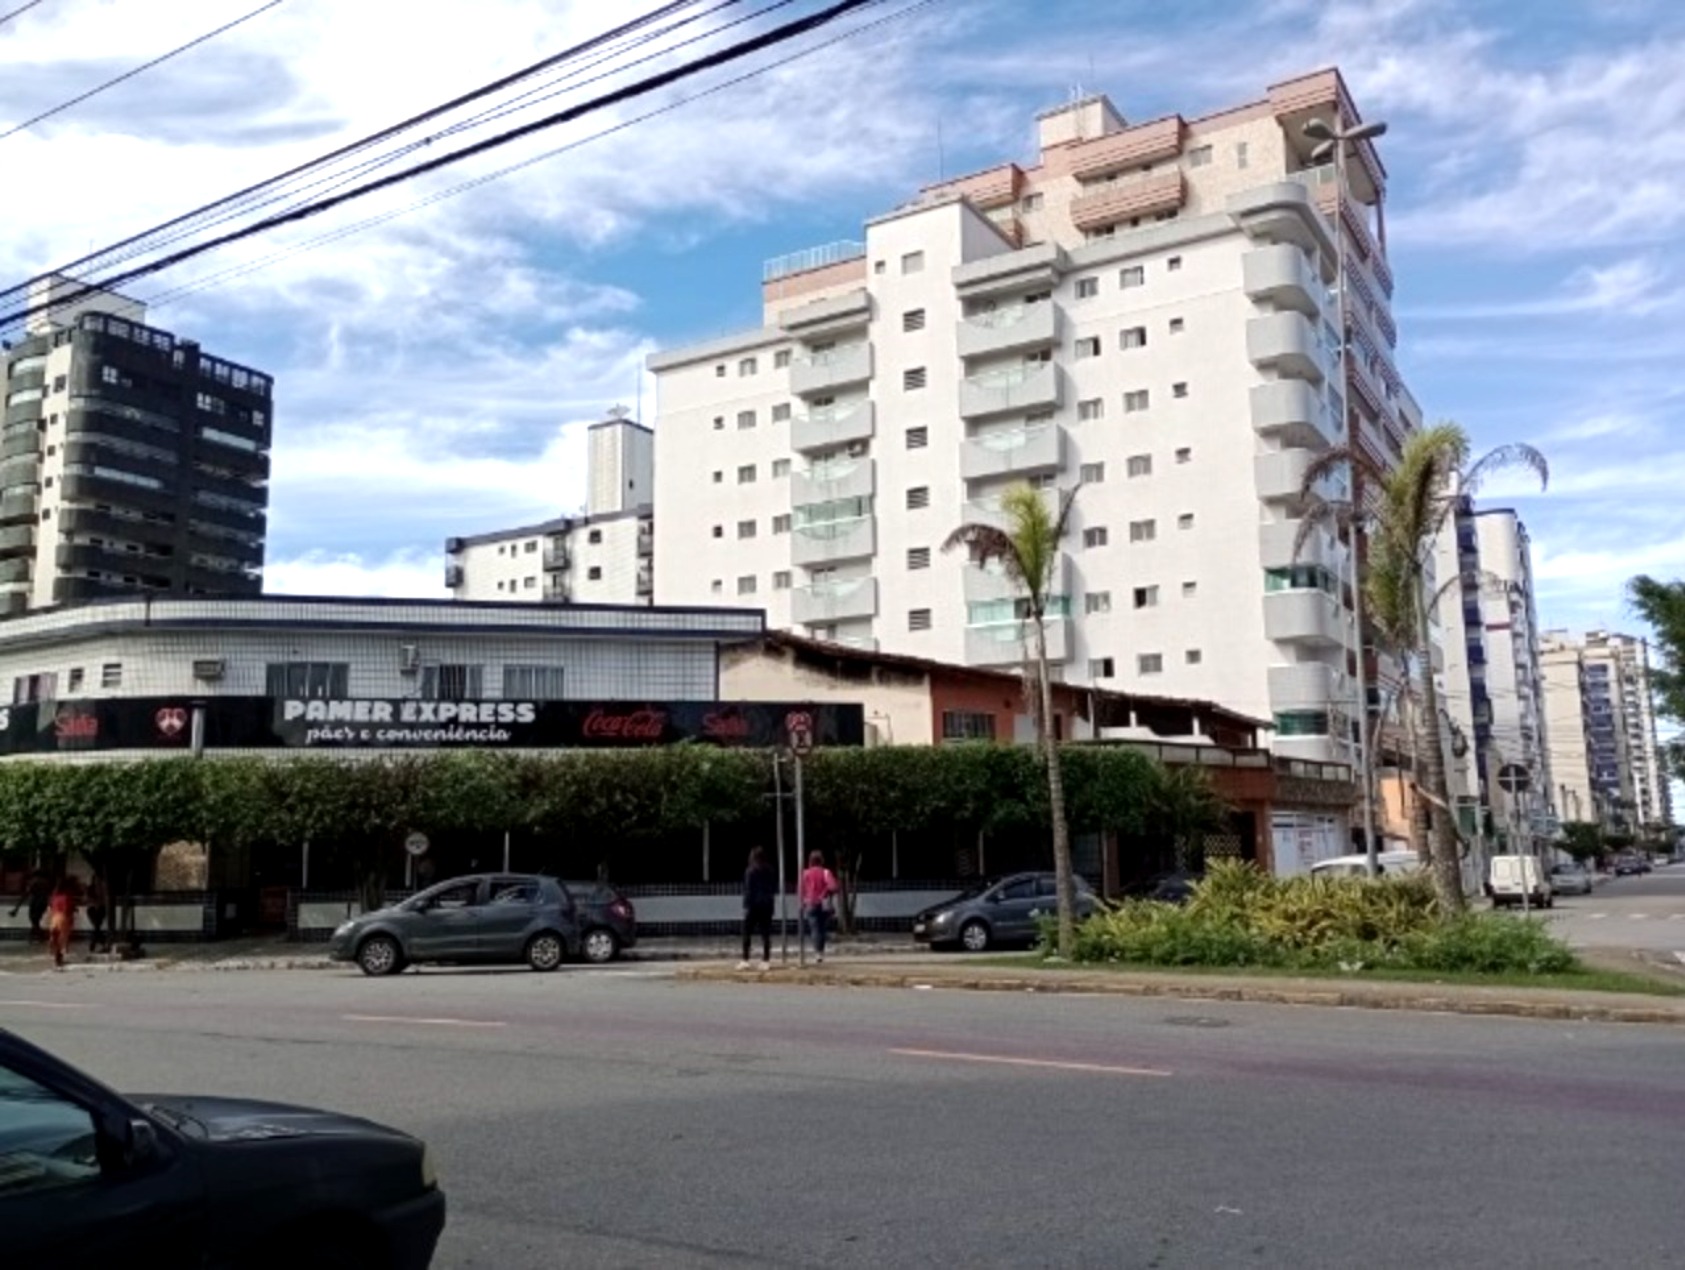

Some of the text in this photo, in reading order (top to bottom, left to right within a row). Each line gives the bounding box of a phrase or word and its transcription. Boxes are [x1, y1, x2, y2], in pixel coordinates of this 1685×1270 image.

[283, 700, 536, 723] PAMER EXPRESS
[360, 728, 371, 740] e
[376, 724, 512, 742] conveniência
